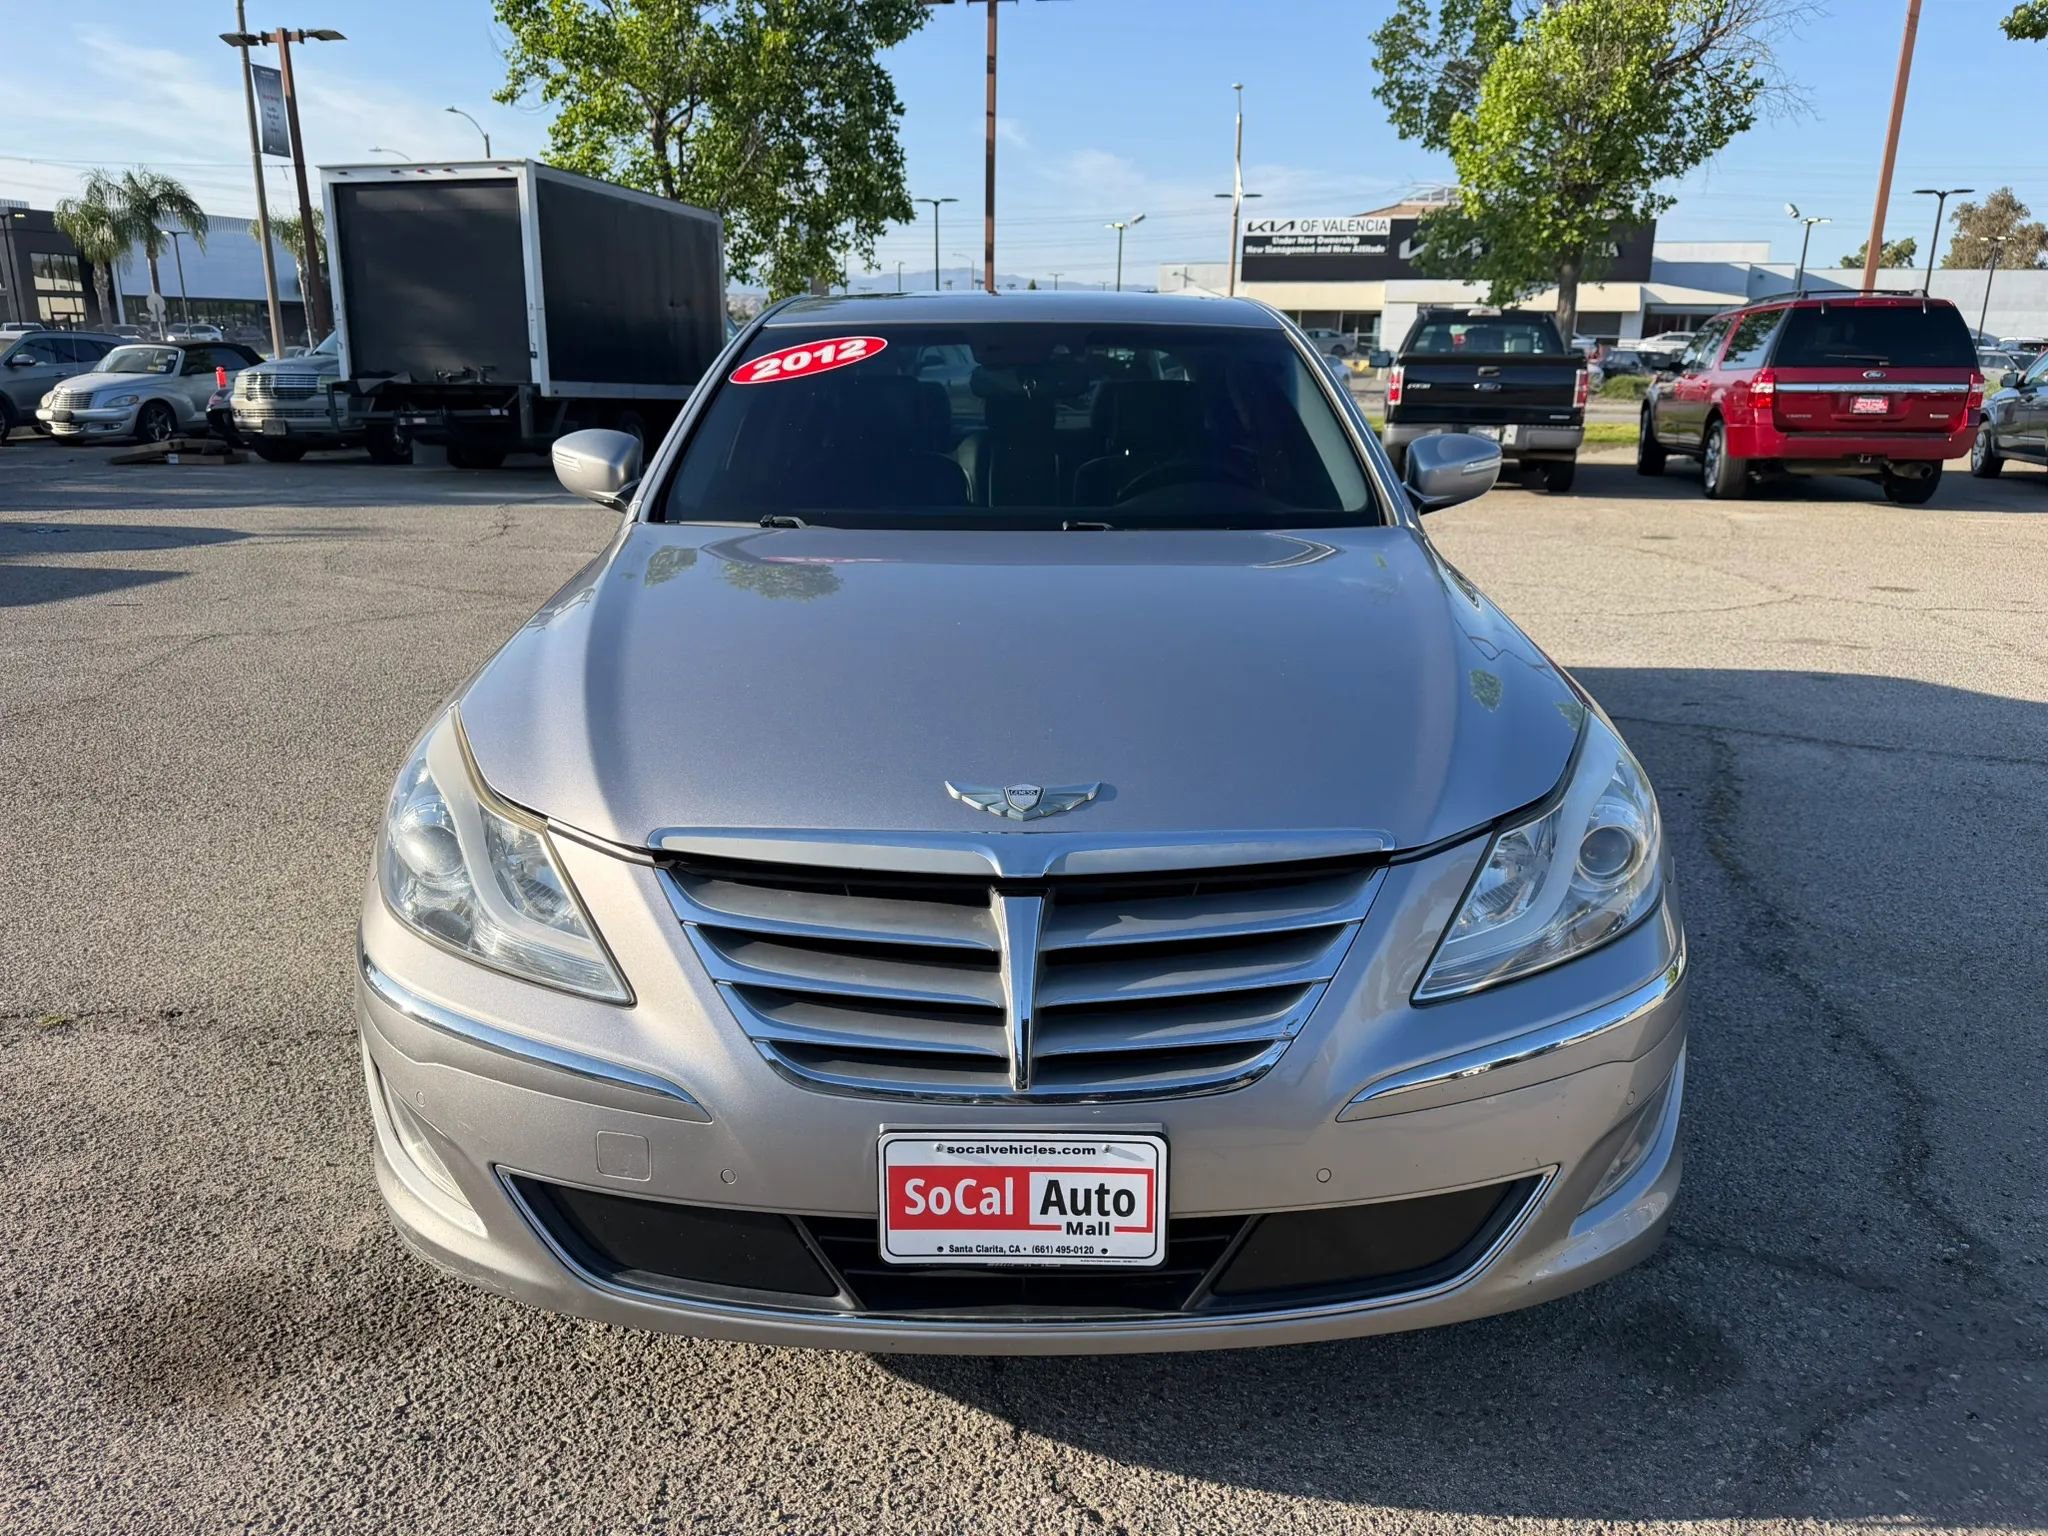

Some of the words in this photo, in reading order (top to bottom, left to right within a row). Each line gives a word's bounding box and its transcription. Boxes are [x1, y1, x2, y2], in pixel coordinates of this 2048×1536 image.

[1247, 220, 1296, 232] KIA
[1300, 220, 1319, 232] OF
[1323, 219, 1388, 232] VALENCIA
[1316, 237, 1360, 246] Ownership
[1352, 245, 1386, 253] Attitude
[751, 339, 867, 381] 2012
[946, 1144, 1096, 1156] socalvehicles.com
[904, 1177, 1014, 1216] SoCal
[1039, 1179, 1136, 1217] Auto
[1065, 1221, 1110, 1236] Mall
[949, 1245, 974, 1254] Santa
[975, 1245, 1007, 1255] Clarita,
[1008, 1245, 1021, 1254] CA
[1031, 1245, 1054, 1255] (661)
[1055, 1245, 1095, 1255] 495-0120
